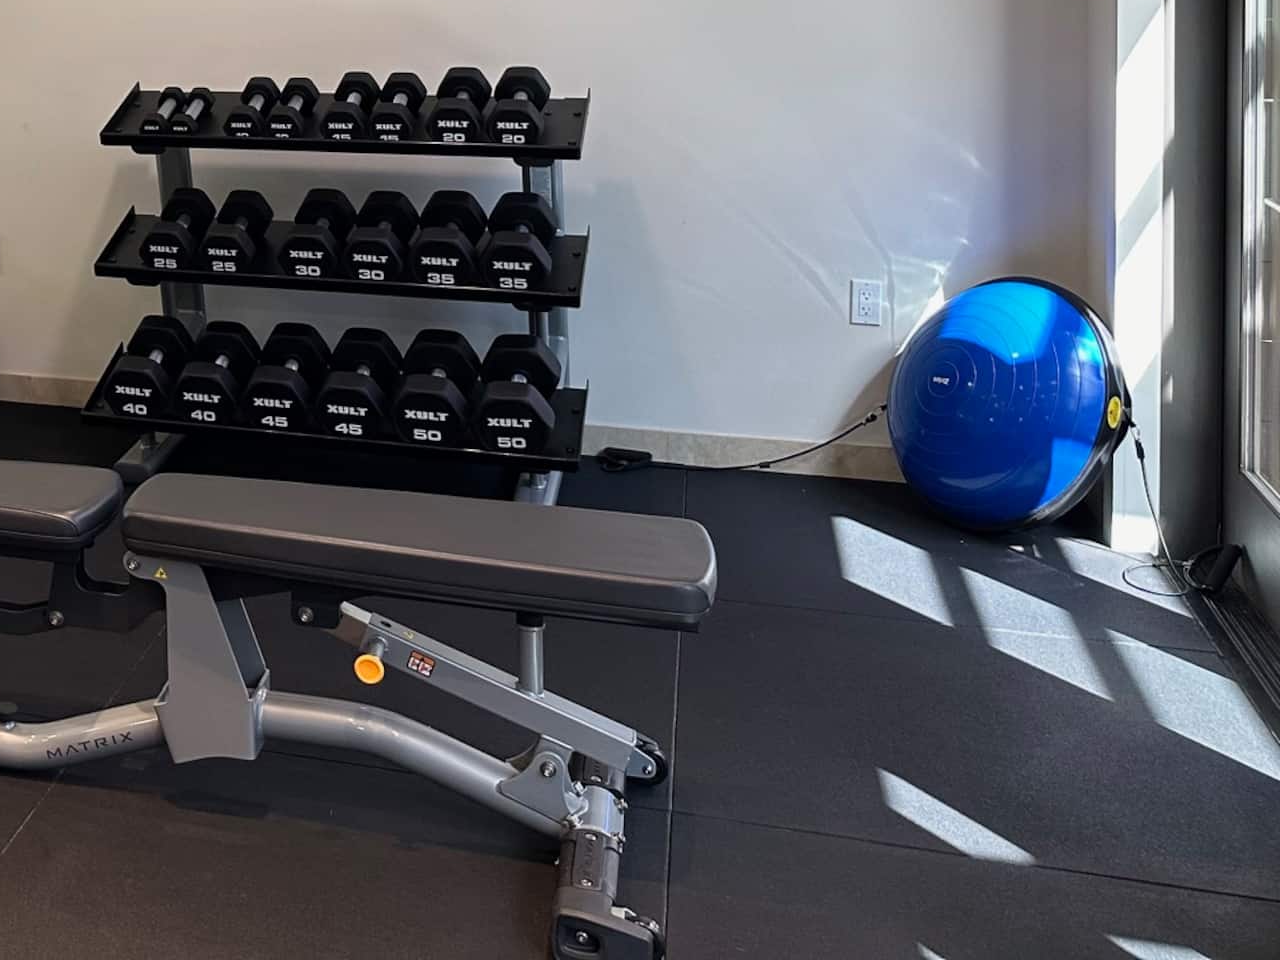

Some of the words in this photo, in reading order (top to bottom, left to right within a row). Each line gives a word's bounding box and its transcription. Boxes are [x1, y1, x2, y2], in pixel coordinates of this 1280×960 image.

[437, 120, 469, 128] XULT
[496, 121, 529, 129] XULT
[442, 133, 465, 142] 20
[502, 134, 525, 144] 20
[149, 245, 179, 253] XULT
[207, 248, 238, 256] XULT
[289, 250, 324, 259] XULT
[153, 258, 177, 269] 25
[352, 253, 389, 263] XULT
[420, 256, 459, 266] XULT
[212, 261, 236, 272] 25
[295, 265, 320, 276] 30
[492, 261, 532, 271] XULT
[358, 269, 384, 280] 30
[427, 272, 455, 284] 35
[499, 277, 527, 289] 35
[115, 385, 152, 397] XULT
[183, 391, 221, 404] XULT
[253, 397, 293, 409] XULT
[122, 403, 148, 415] 40
[326, 404, 368, 417] XULT
[191, 409, 216, 422] 40
[404, 409, 449, 422] XULT
[261, 416, 288, 428] 45
[487, 417, 533, 428] XULT
[334, 423, 363, 435] 45
[413, 428, 442, 441] 50
[497, 437, 527, 449] 50
[45, 731, 135, 759] MATRIX
